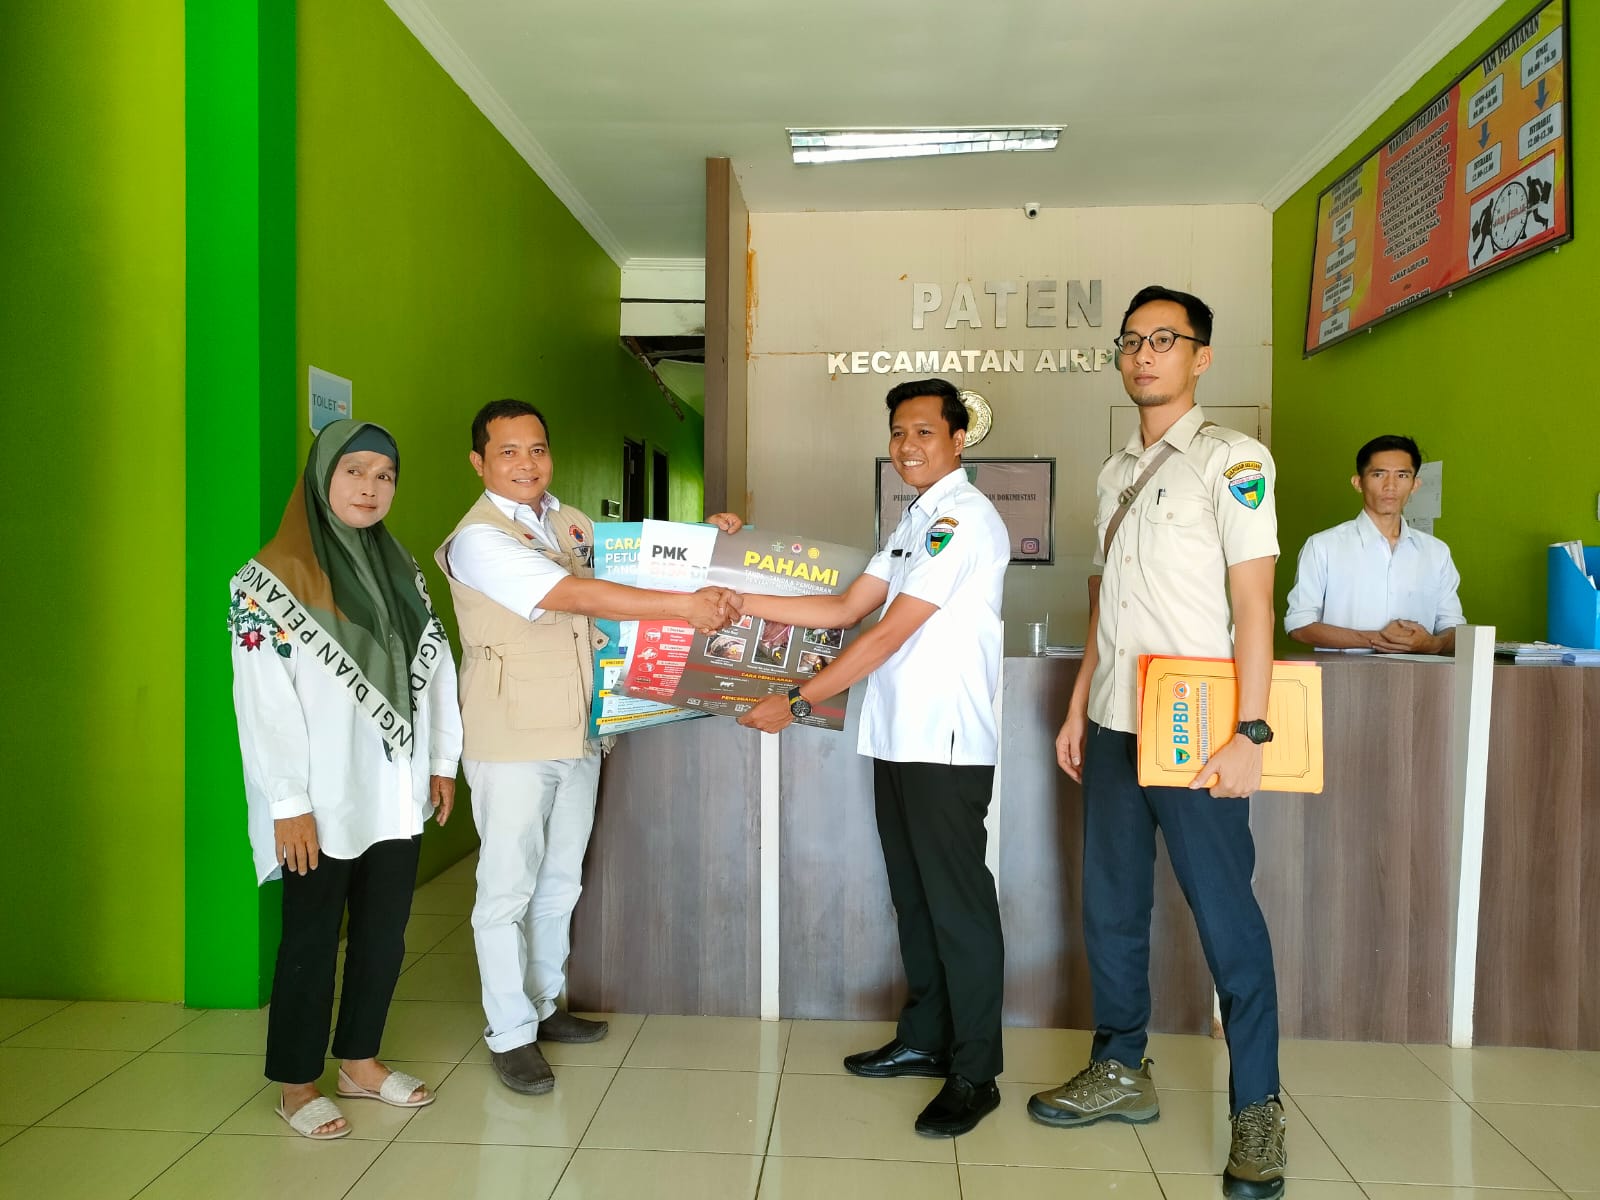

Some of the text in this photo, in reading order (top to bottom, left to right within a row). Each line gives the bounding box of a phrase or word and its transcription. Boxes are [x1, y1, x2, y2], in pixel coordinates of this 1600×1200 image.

[912, 280, 1103, 329] PATEN
[827, 350, 1024, 374] KECAMATAN
[312, 393, 337, 412] TOILET
[605, 537, 641, 551] CARA
[652, 544, 688, 561] PMK
[743, 551, 839, 586] PAHAMI
[317, 642, 370, 703] DIAN
[1172, 701, 1189, 744] BPBD
